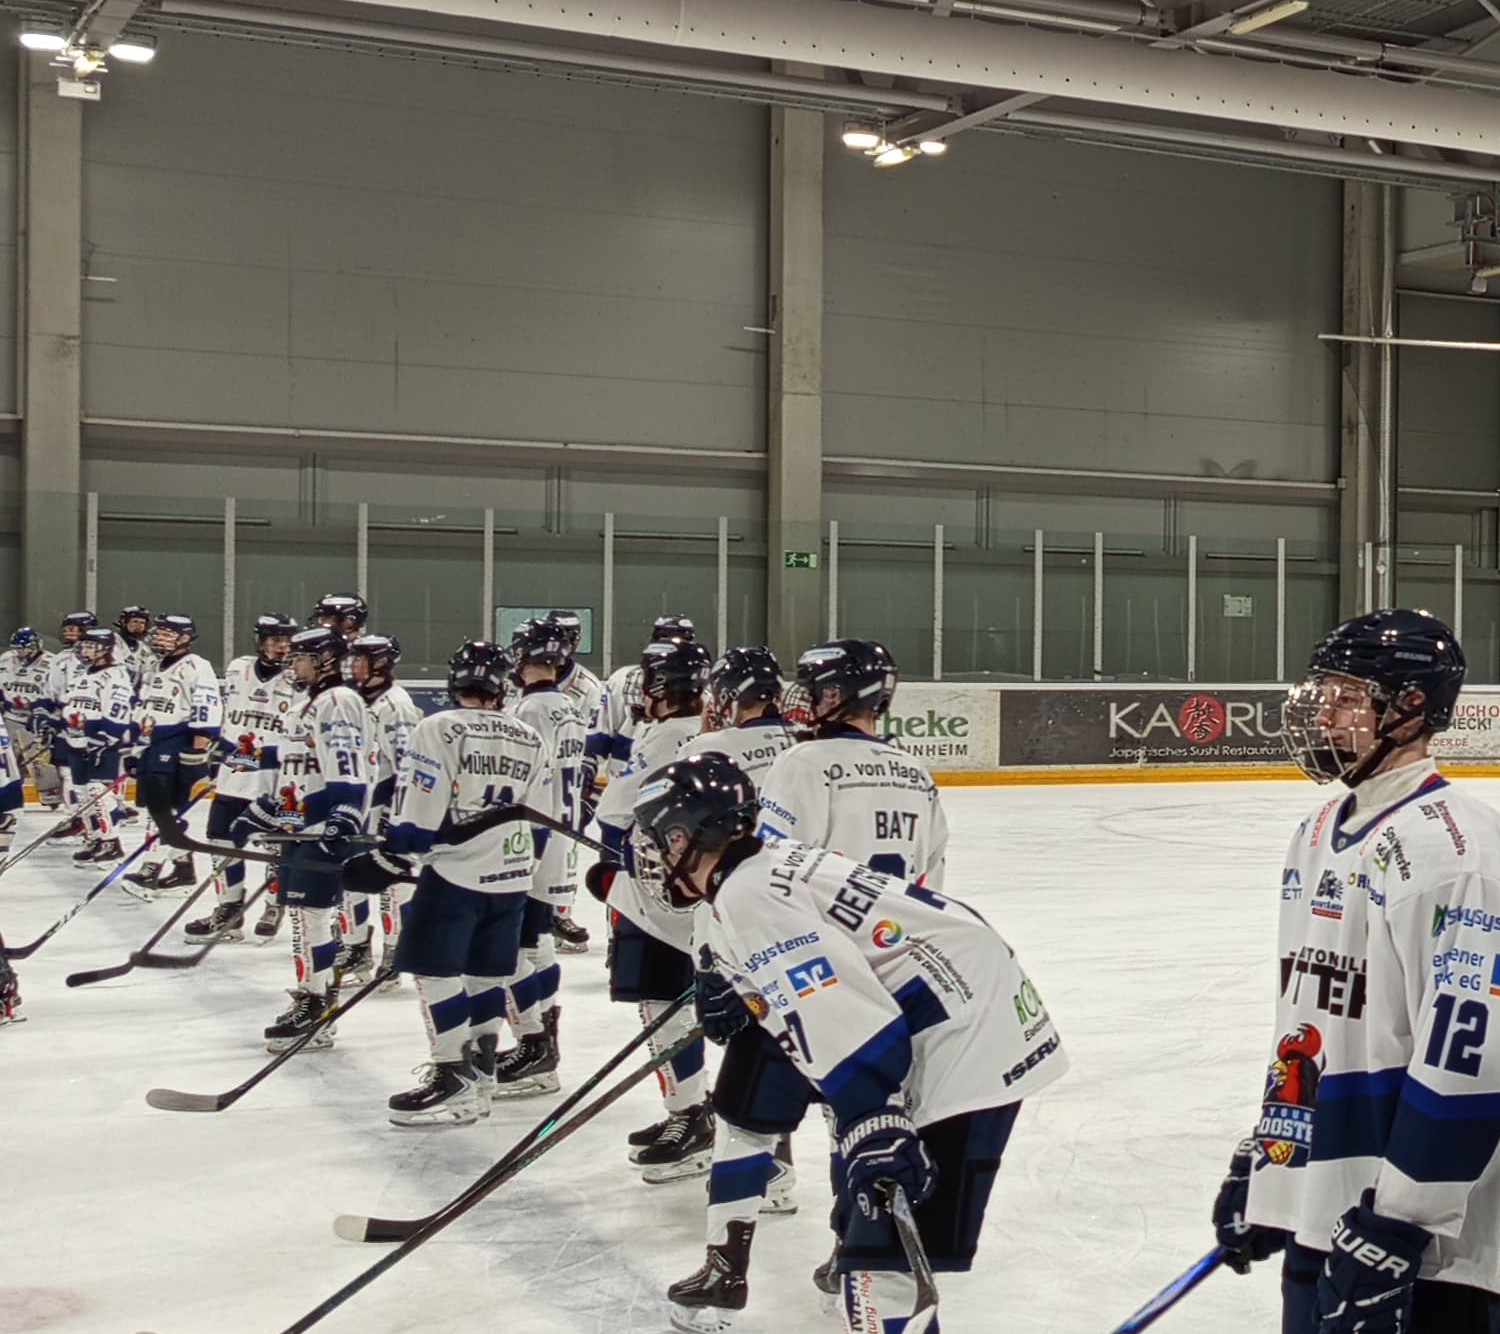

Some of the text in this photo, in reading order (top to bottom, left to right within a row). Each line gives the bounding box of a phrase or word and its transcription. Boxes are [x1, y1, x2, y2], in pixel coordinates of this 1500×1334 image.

[1455, 704, 1486, 718] UCH
[1449, 718, 1492, 731] HECK!
[1189, 744, 1220, 757] Sushi
[1221, 744, 1287, 757] Restaurant
[855, 763, 887, 777] von
[1458, 974, 1482, 991] eG
[1424, 992, 1490, 1078] 12
